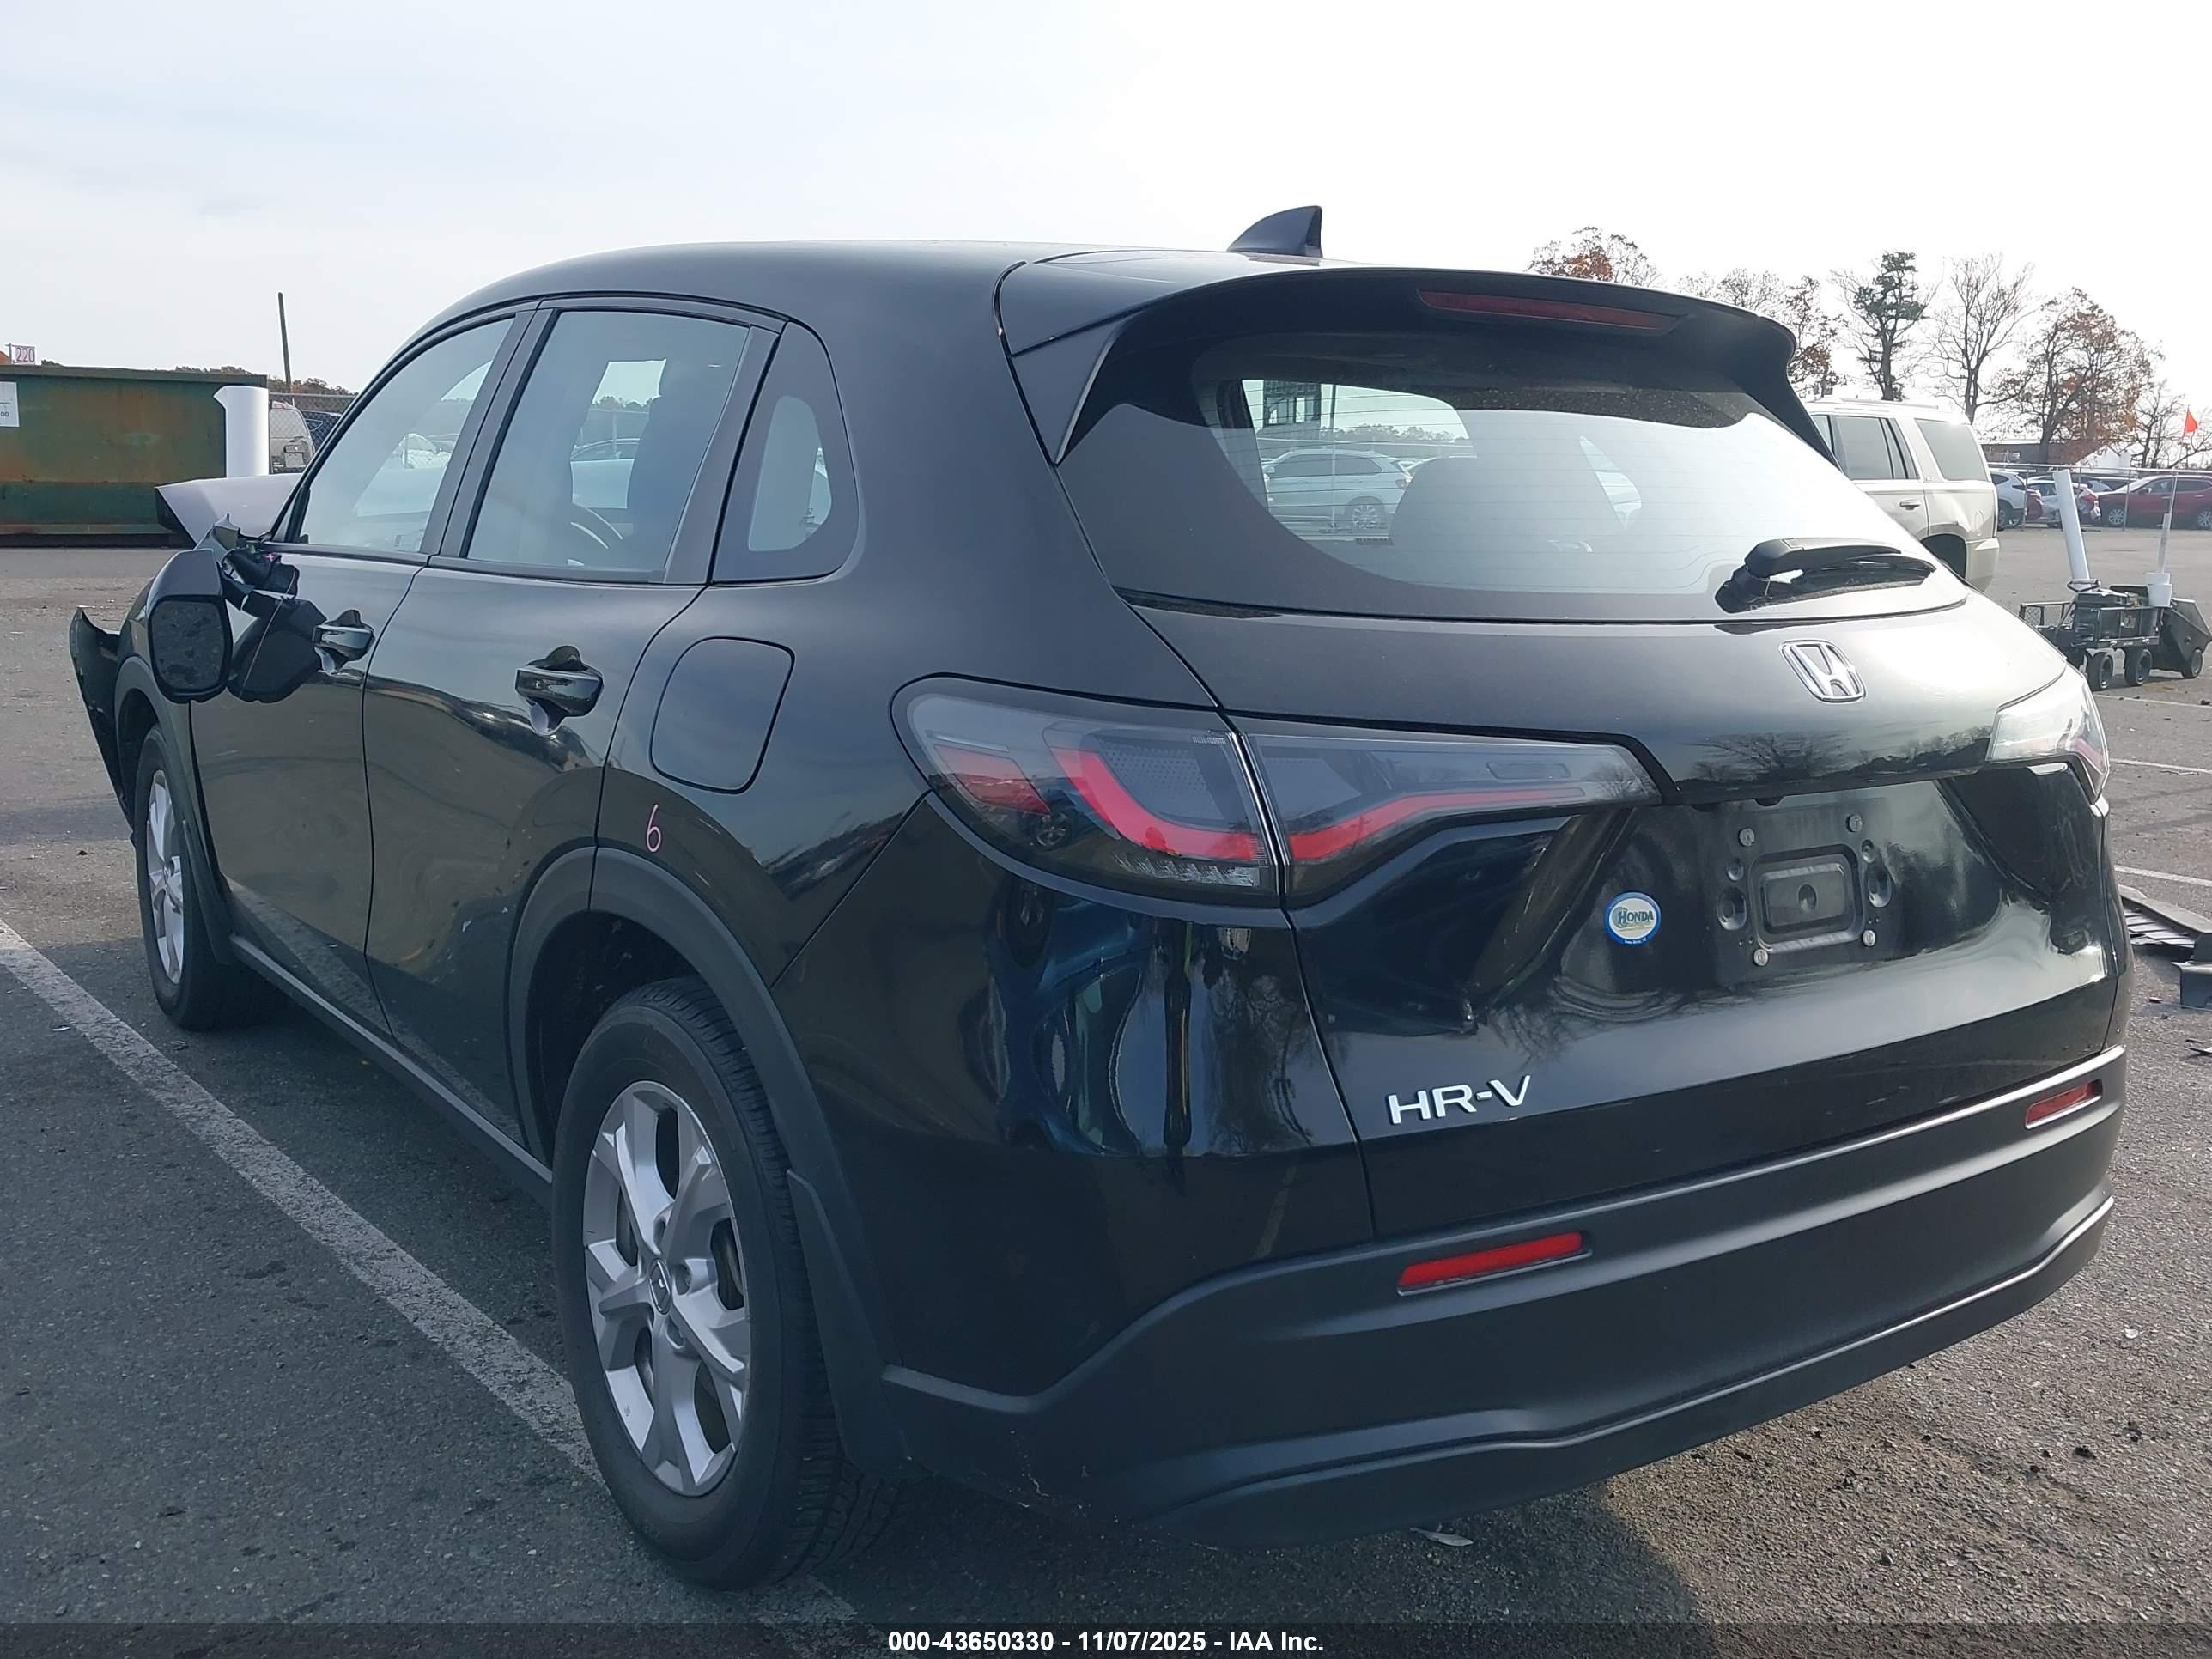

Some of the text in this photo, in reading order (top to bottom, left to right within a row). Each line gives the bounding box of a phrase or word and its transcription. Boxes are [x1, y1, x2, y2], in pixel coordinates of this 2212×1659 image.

[15, 347, 35, 362] 220
[647, 804, 662, 853] 6
[1618, 908, 1655, 925] HONDA
[1387, 1074, 1532, 1125] HR-V
